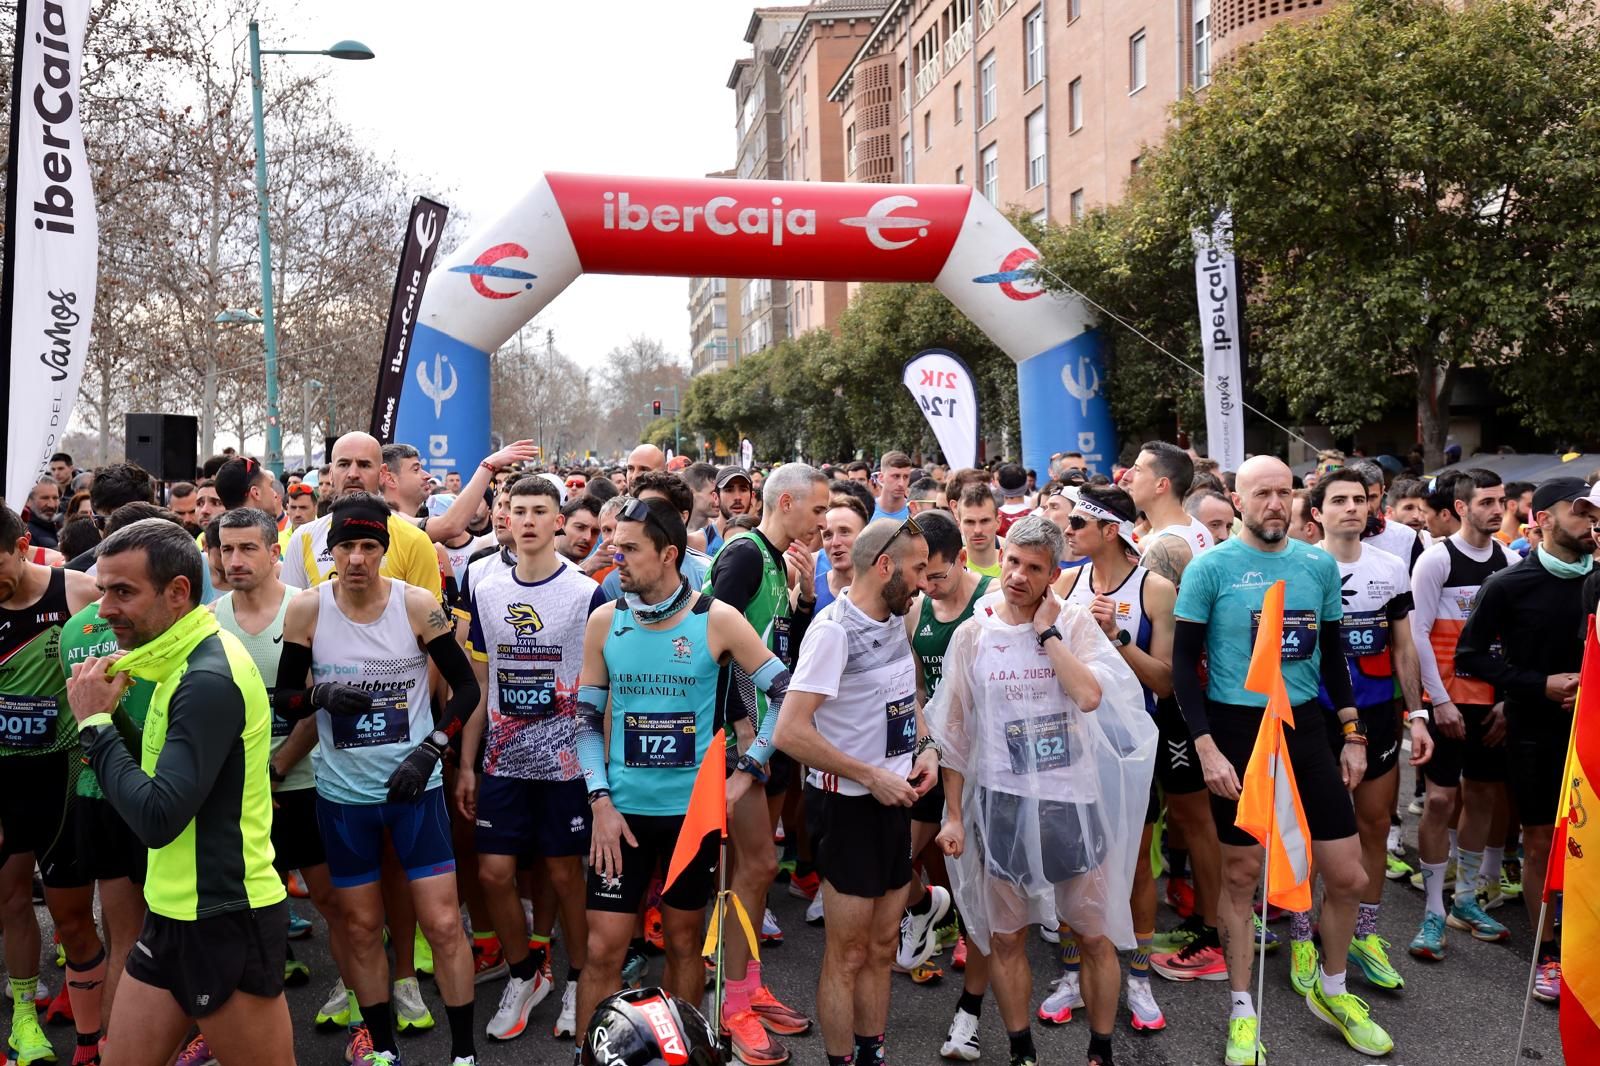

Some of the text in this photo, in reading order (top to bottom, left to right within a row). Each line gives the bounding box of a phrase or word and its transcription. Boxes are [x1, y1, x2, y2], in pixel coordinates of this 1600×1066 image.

[603, 191, 816, 246] iberCaja
[50, 392, 63, 427] DEL
[1348, 629, 1374, 645] 86
[511, 646, 531, 654] MEDIA
[531, 645, 561, 655] MARATÓN
[634, 673, 696, 687] ATLETISMO
[1024, 667, 1056, 680] ZUERA
[501, 688, 551, 705] 10026
[356, 712, 387, 732] 45
[639, 735, 677, 754] 172
